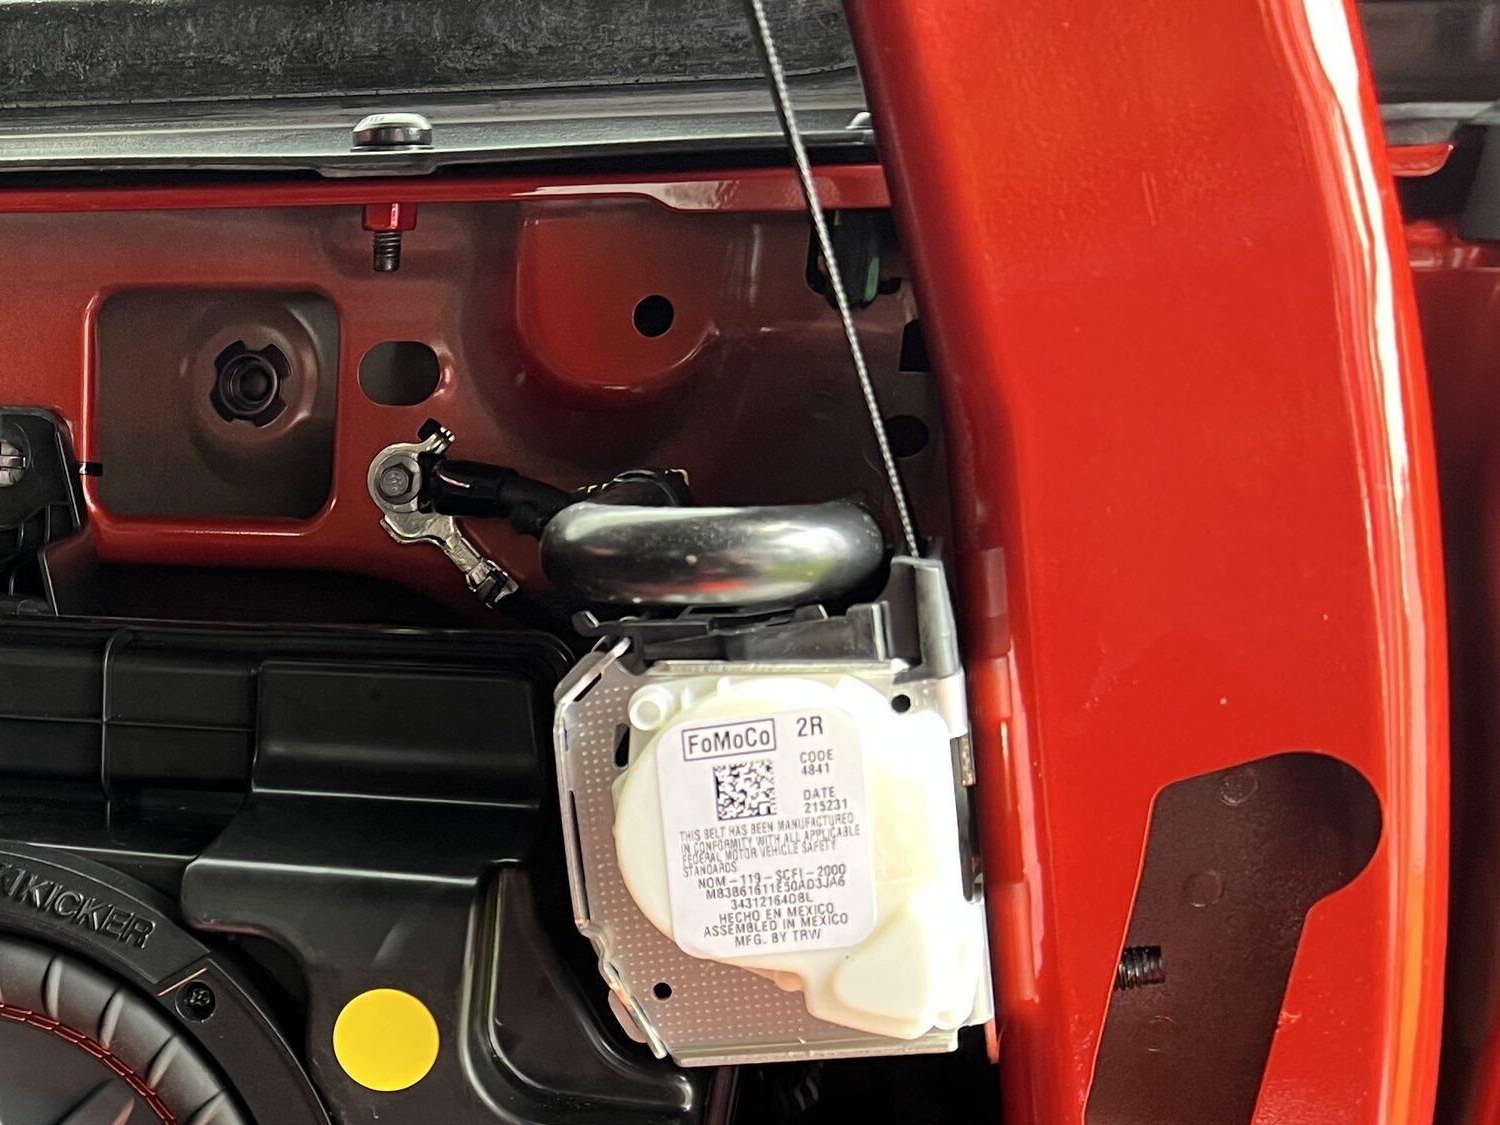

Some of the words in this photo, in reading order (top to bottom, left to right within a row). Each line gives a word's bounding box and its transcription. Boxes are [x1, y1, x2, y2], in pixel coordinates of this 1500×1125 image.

[796, 716, 824, 738] 2R
[687, 727, 772, 756] FoMoCo
[799, 749, 834, 764] CODE
[800, 763, 831, 776] 4841
[802, 786, 836, 801] DATE
[803, 798, 849, 815] 215231
[679, 830, 701, 842] THIS
[703, 827, 726, 840] BELT
[729, 824, 748, 837] HAS
[750, 822, 774, 835] BEEN
[777, 812, 854, 832] MANUFACTURED
[693, 836, 753, 854] CONFORMITY
[756, 833, 781, 848] WITH
[783, 831, 801, 844] ALL
[804, 823, 861, 843] APPLICABLE
[682, 850, 722, 866] FEDERAL
[725, 846, 758, 862] MOTOR
[761, 842, 799, 858] VEHICLE
[802, 838, 837, 853] SAFETY
[682, 861, 738, 878] STANDARDS
[20, 872, 156, 949] KICKER
[718, 910, 761, 925] HECHO
[765, 908, 783, 921] EN
[786, 902, 835, 918] MEXICO
[703, 920, 778, 938] ASSEMBLED
[782, 918, 796, 930] IN
[800, 912, 849, 927] MEXICO
[771, 932, 787, 944] BY
[793, 929, 822, 942] TRW
